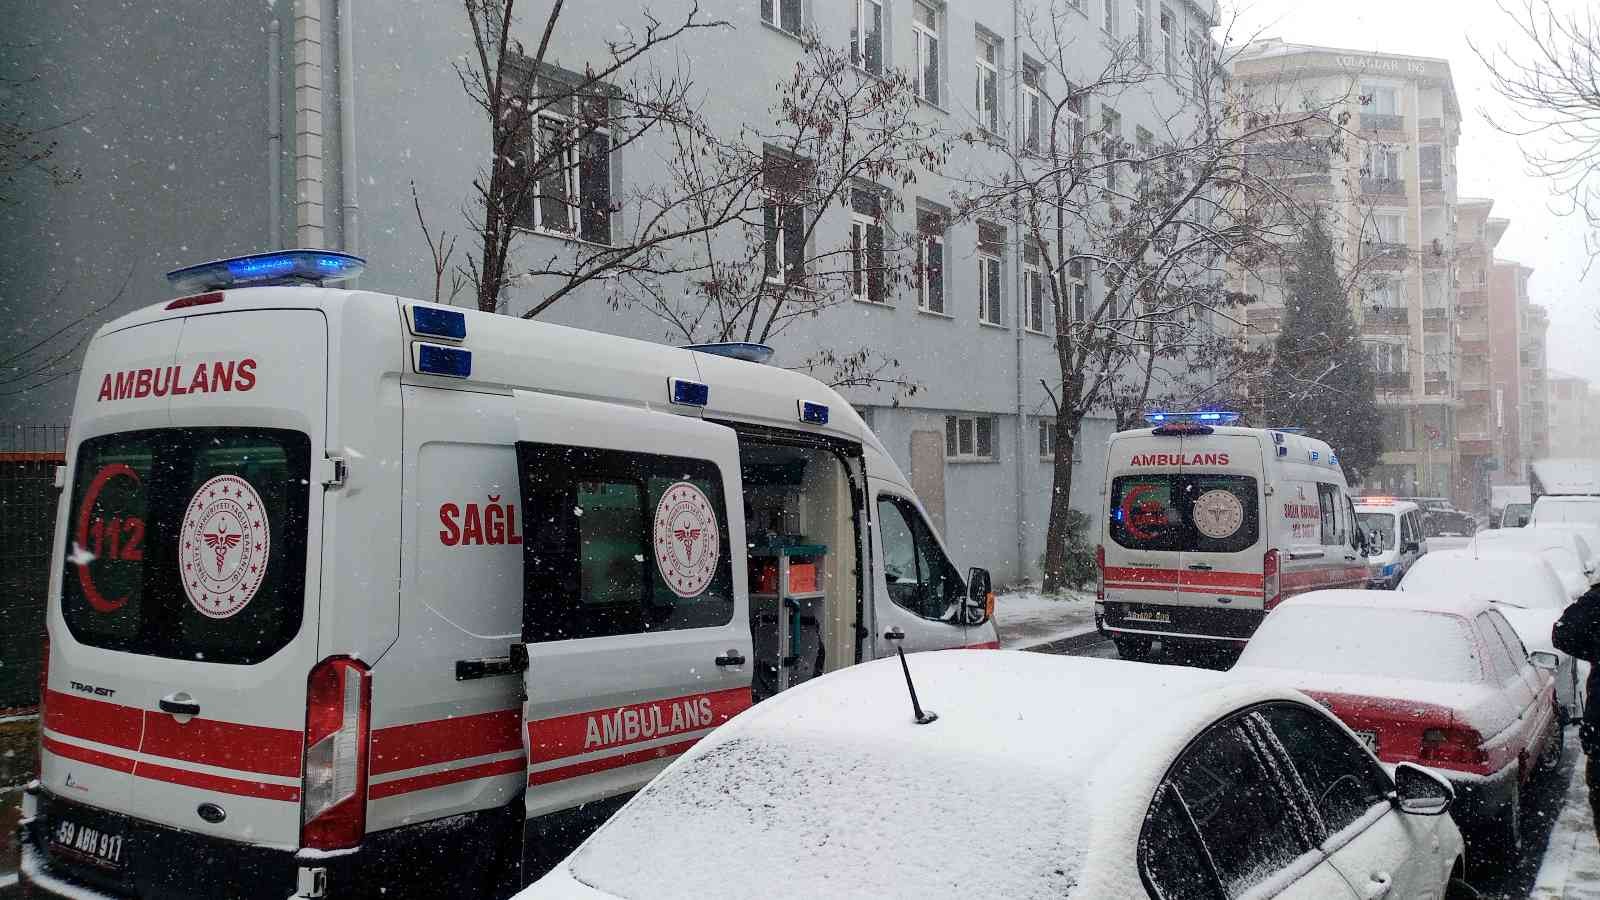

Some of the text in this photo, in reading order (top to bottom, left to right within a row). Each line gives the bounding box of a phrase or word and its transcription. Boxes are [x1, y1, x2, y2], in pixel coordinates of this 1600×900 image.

[97, 358, 257, 402] AMBULANS
[1130, 453, 1230, 466] AMBULANS
[93, 515, 145, 561] 112
[439, 494, 523, 547] SAĞL
[584, 697, 713, 749] AMBULANS
[60, 820, 122, 862] 59 ABH 911
